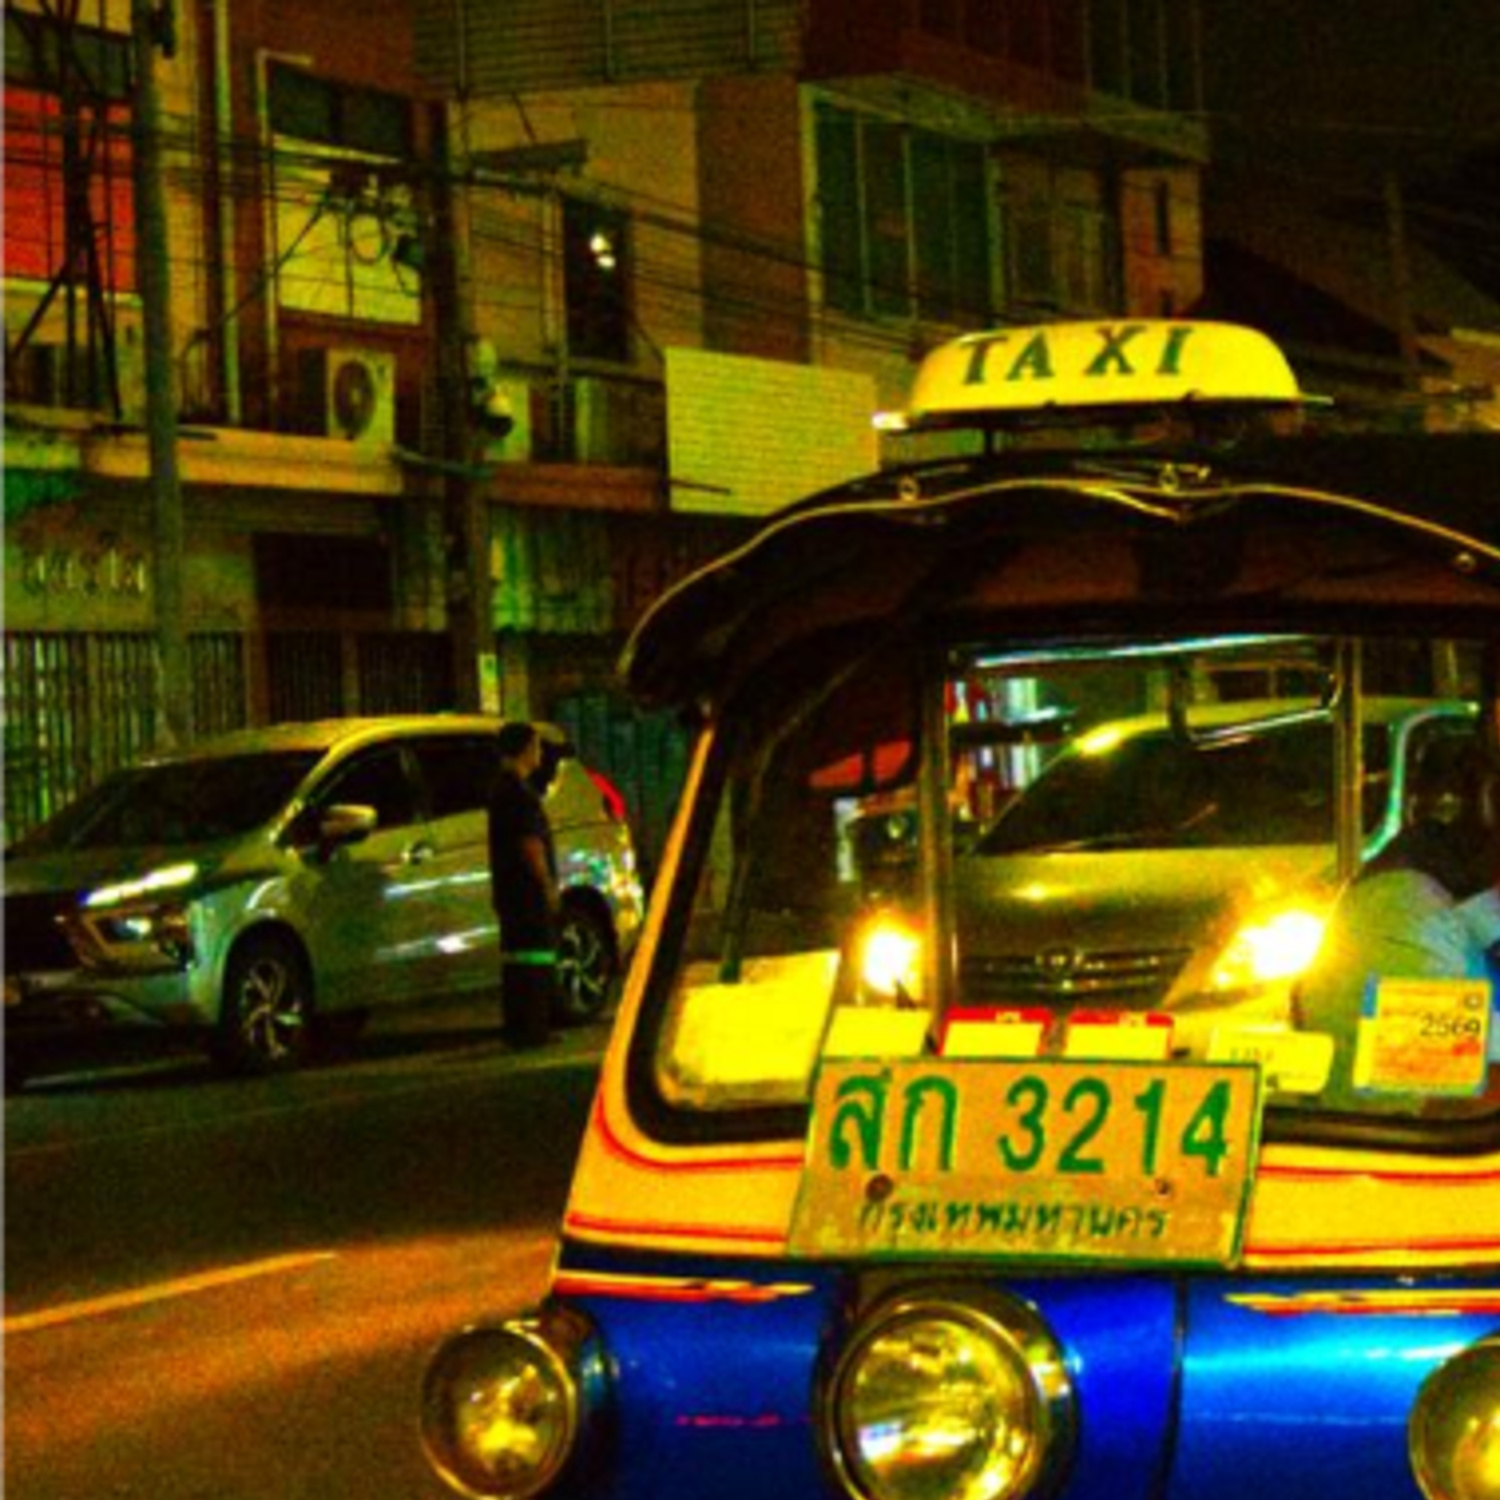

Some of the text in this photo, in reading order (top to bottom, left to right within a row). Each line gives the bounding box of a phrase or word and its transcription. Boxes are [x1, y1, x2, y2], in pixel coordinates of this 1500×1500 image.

[959, 326, 1195, 385] TAXI
[828, 1067, 1232, 1177] สก 3214
